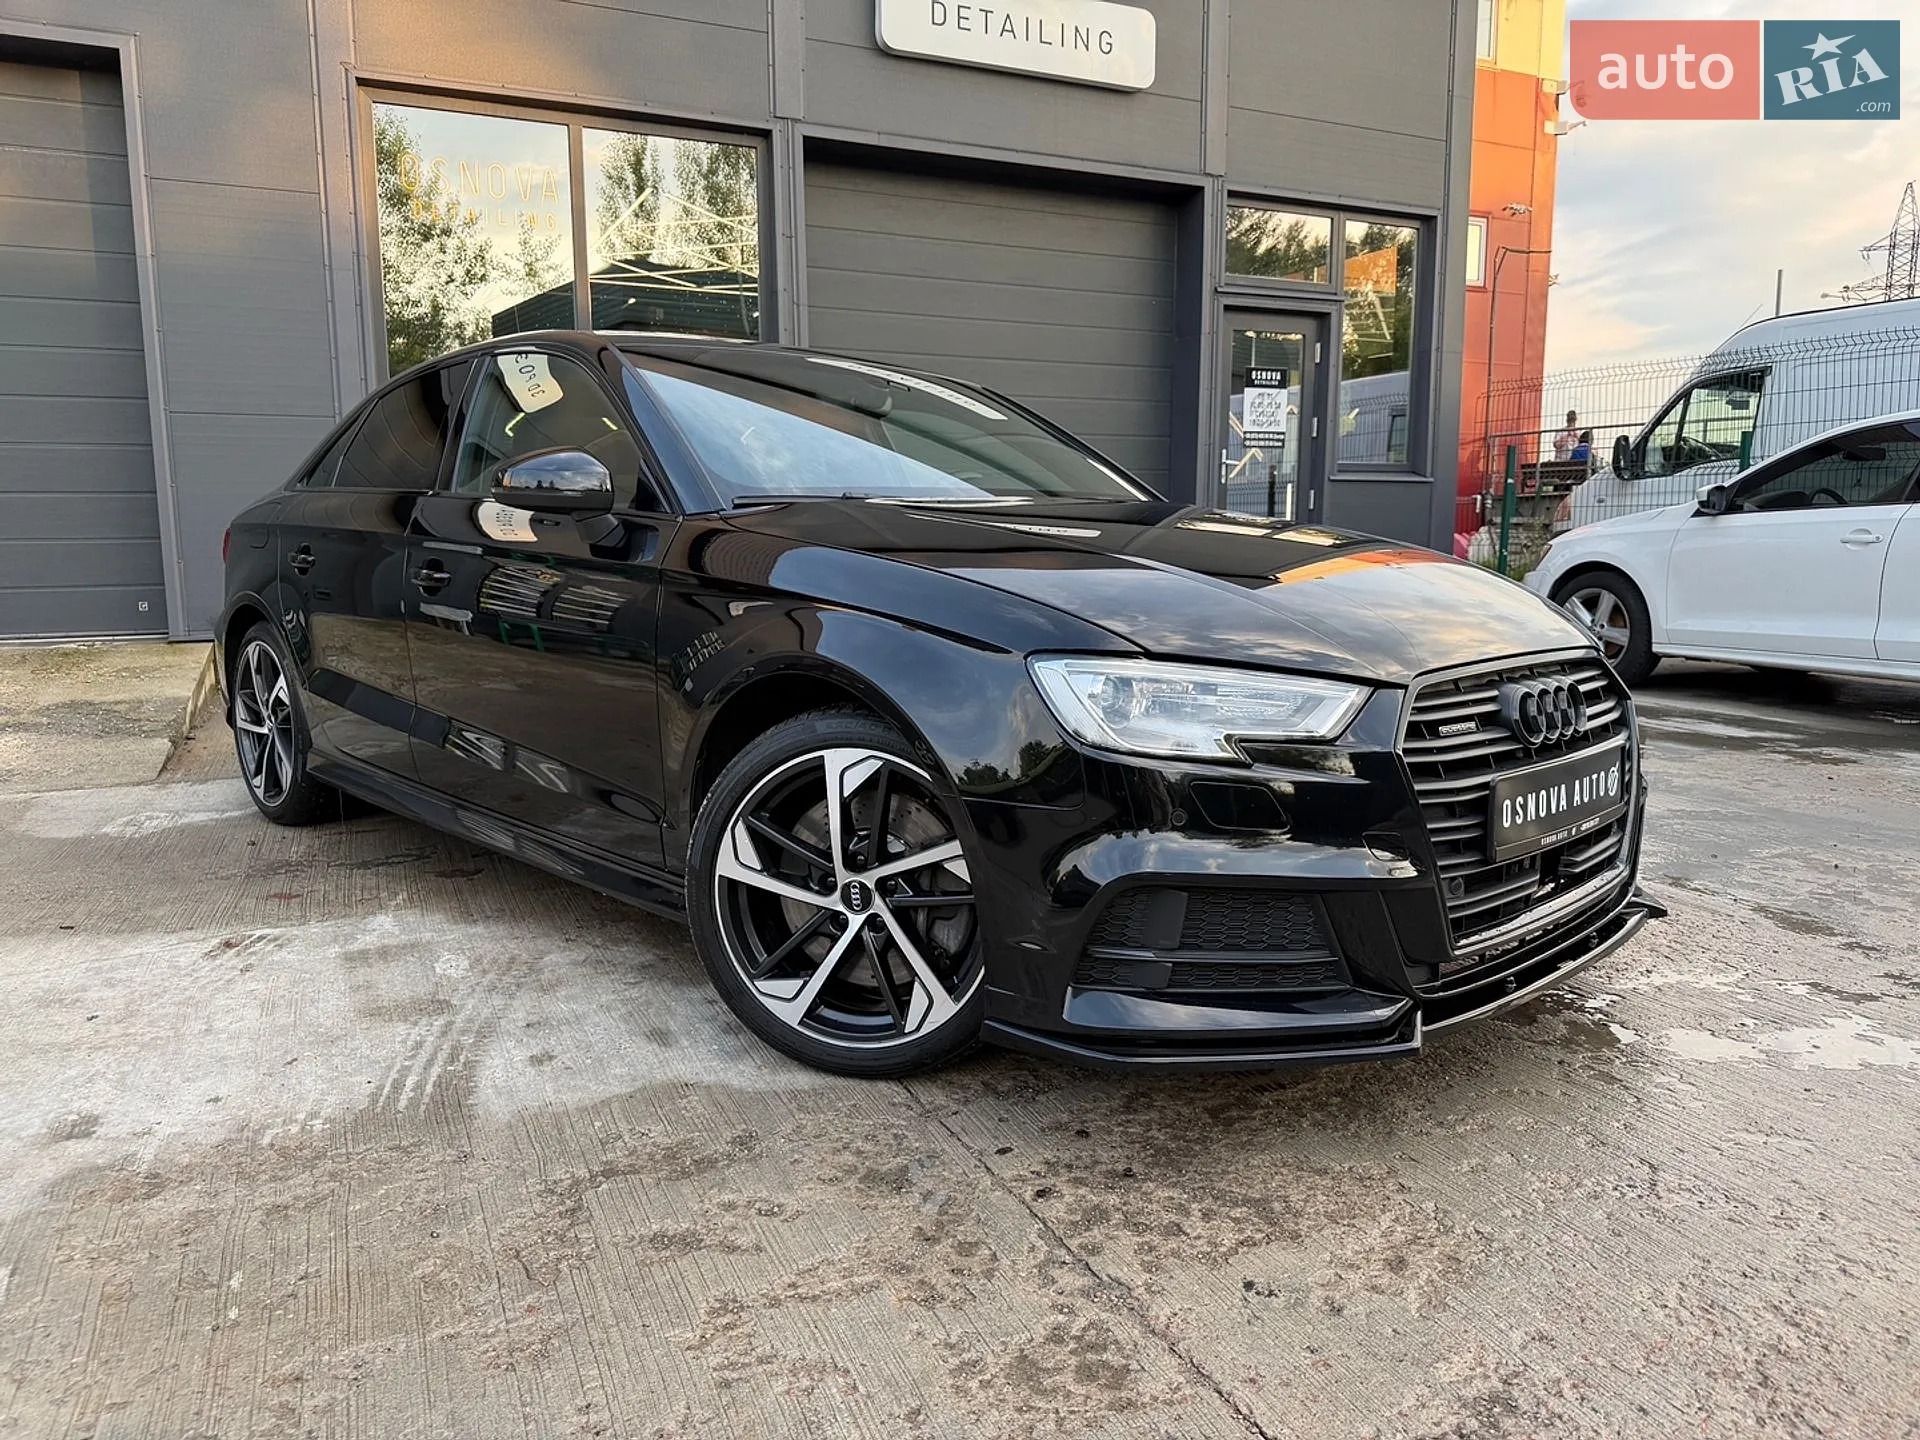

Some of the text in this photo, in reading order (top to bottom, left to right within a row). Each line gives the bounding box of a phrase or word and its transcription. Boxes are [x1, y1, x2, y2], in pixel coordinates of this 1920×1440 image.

[931, 0, 1113, 54] DETAILING
[400, 153, 560, 204] OSNOVA
[412, 200, 557, 231] DETAILING
[1502, 770, 1606, 828] OSNOVA AUTO
